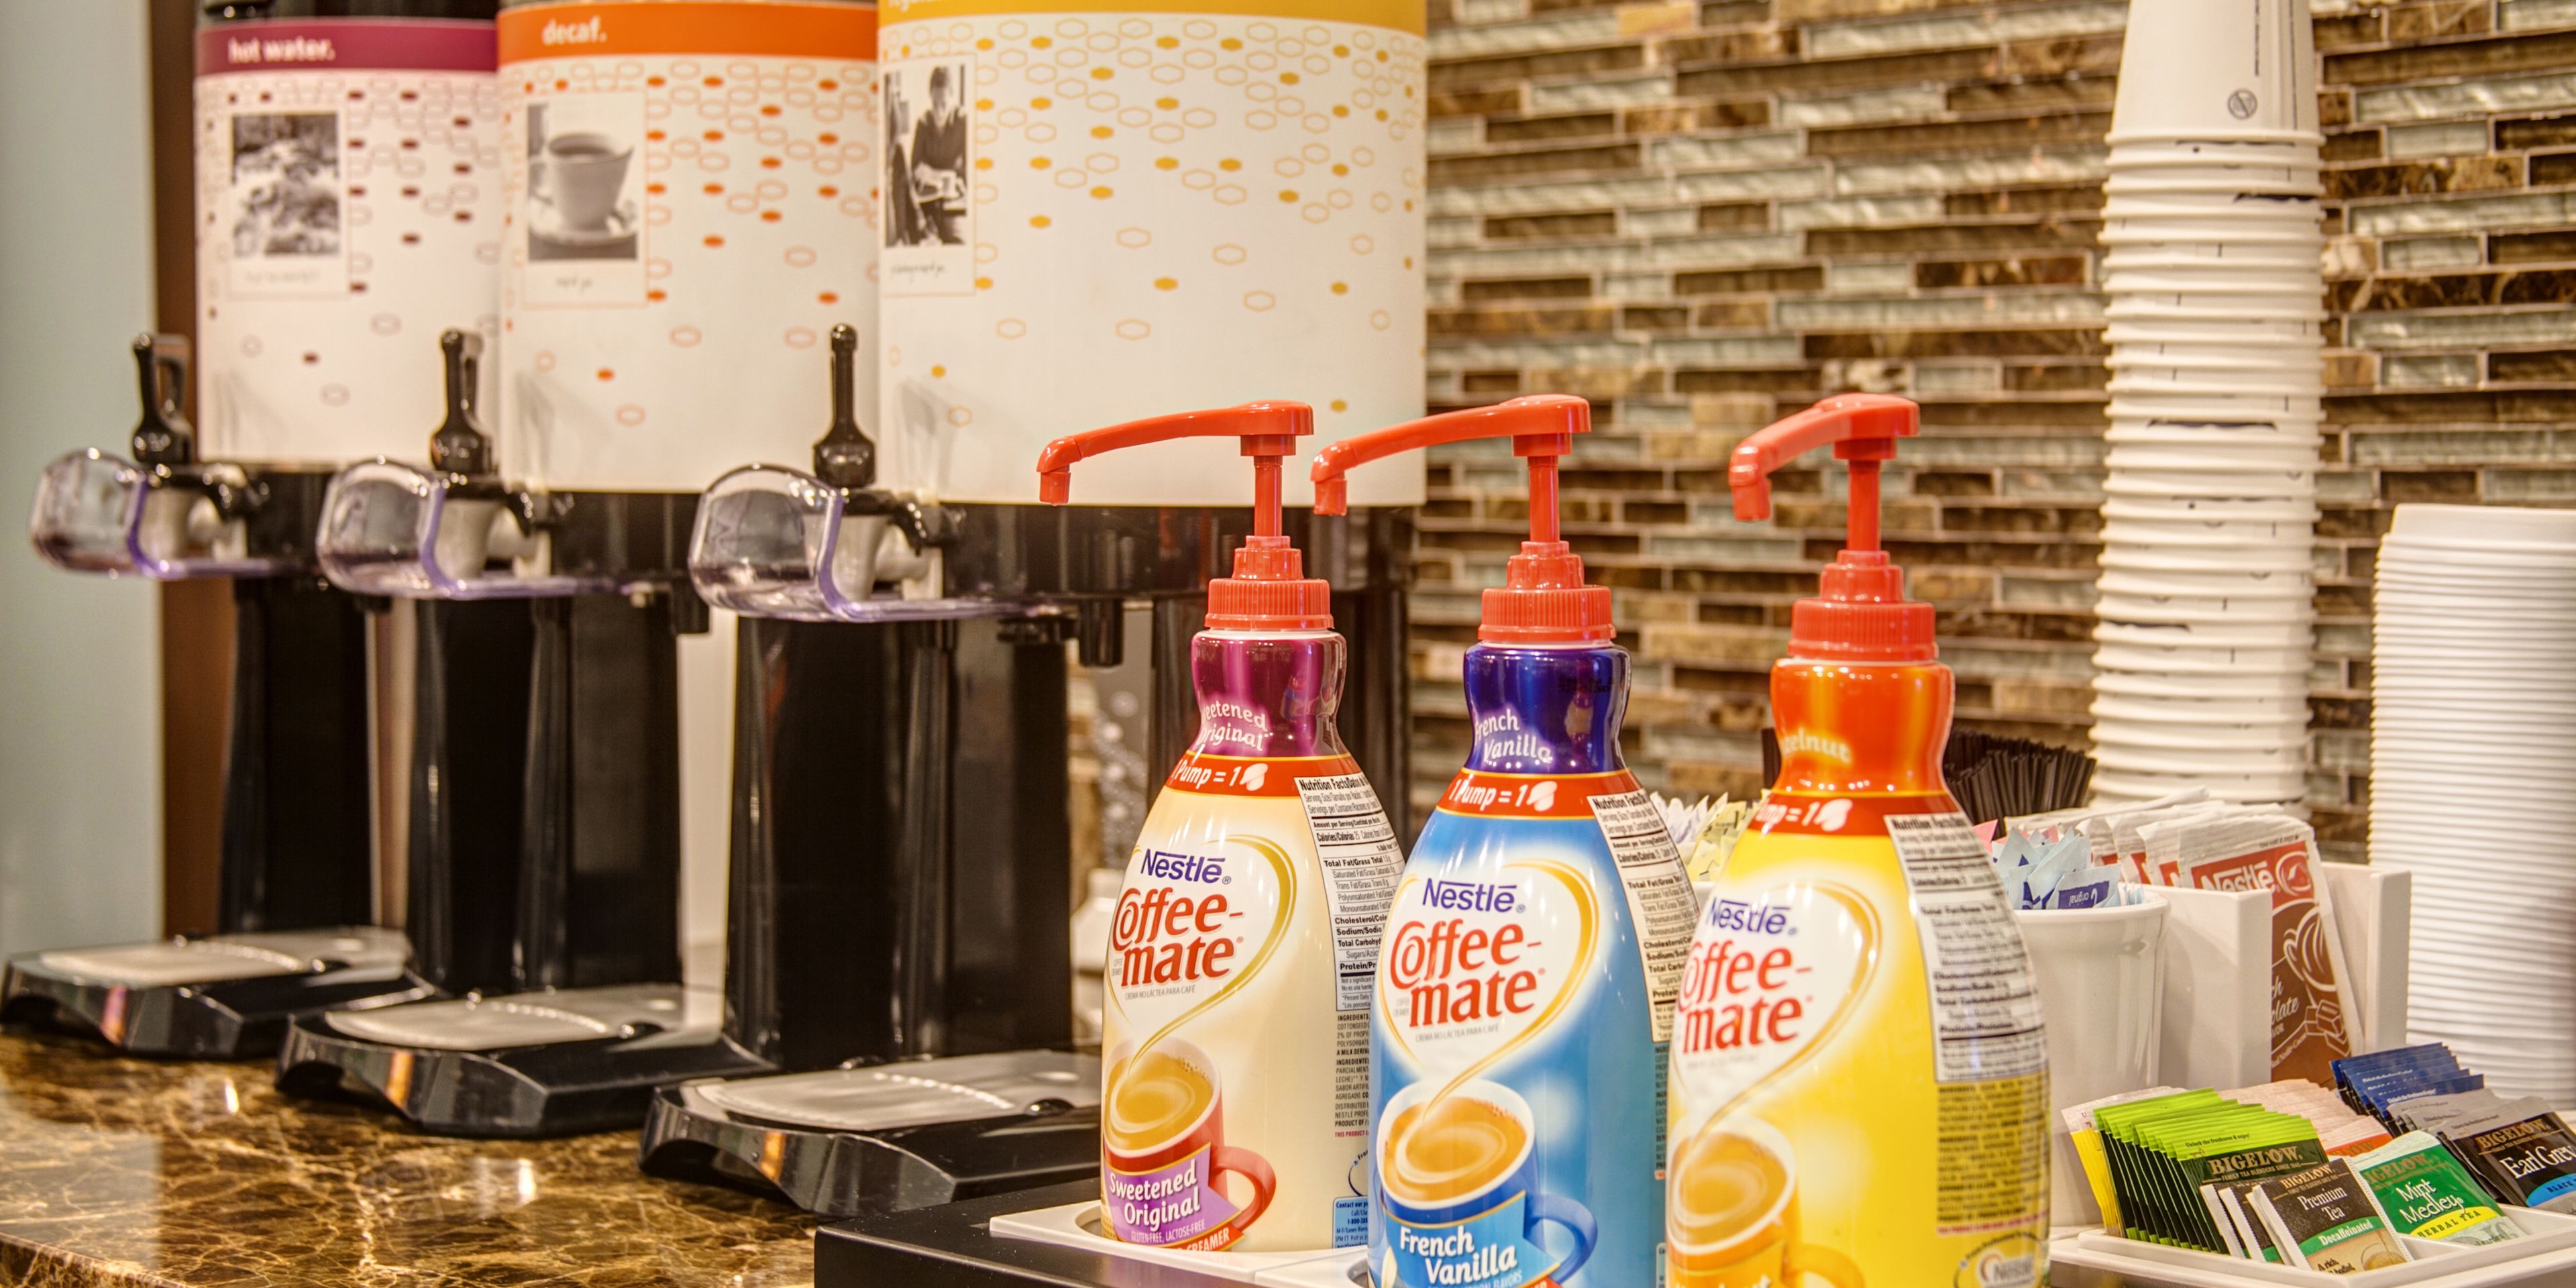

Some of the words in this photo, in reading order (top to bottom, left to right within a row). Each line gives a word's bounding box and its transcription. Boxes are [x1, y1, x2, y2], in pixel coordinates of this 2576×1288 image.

[542, 18, 606, 46] decaf.
[227, 36, 262, 64] hot
[262, 35, 337, 62] water.
[1202, 700, 1267, 731] eetened
[1484, 733, 1554, 764] Vanilla
[1175, 759, 1212, 790] Pump
[1299, 778, 1332, 791] Nutrition
[1454, 779, 1497, 811] Pump
[1140, 849, 1226, 883] Nestlé
[1324, 859, 1341, 867] Total
[1336, 882, 1349, 890] Trans
[1422, 878, 1517, 913] Nestlé
[1338, 939, 1354, 947] Total
[1121, 936, 1235, 987] mate
[1166, 987, 1179, 996] PARA
[1409, 970, 1537, 1027] mate
[1337, 1022, 1367, 1030] COTTONSEED
[1683, 996, 1803, 1054] mate
[2221, 1173, 2239, 1181] FAMILY
[2250, 1166, 2276, 1175] BLENDERS
[2364, 1153, 2426, 1184] IGELOW
[2499, 1150, 2546, 1179] Earl
[1110, 1159, 1197, 1201] Sweetened
[2396, 1179, 2436, 1201] Mint
[1124, 1186, 1201, 1232] Original
[2297, 1187, 2347, 1211] Premium
[2321, 1205, 2345, 1221] Tea
[1165, 1220, 1205, 1241] LACTOSE-FREE
[2318, 1219, 2373, 1246] Decaffeinated
[2418, 1219, 2458, 1237] HERBAL
[2460, 1210, 2481, 1222] TEA
[1399, 1225, 1475, 1258] French
[1424, 1243, 1518, 1284] Vanilla
[2318, 1263, 2325, 1271] A
